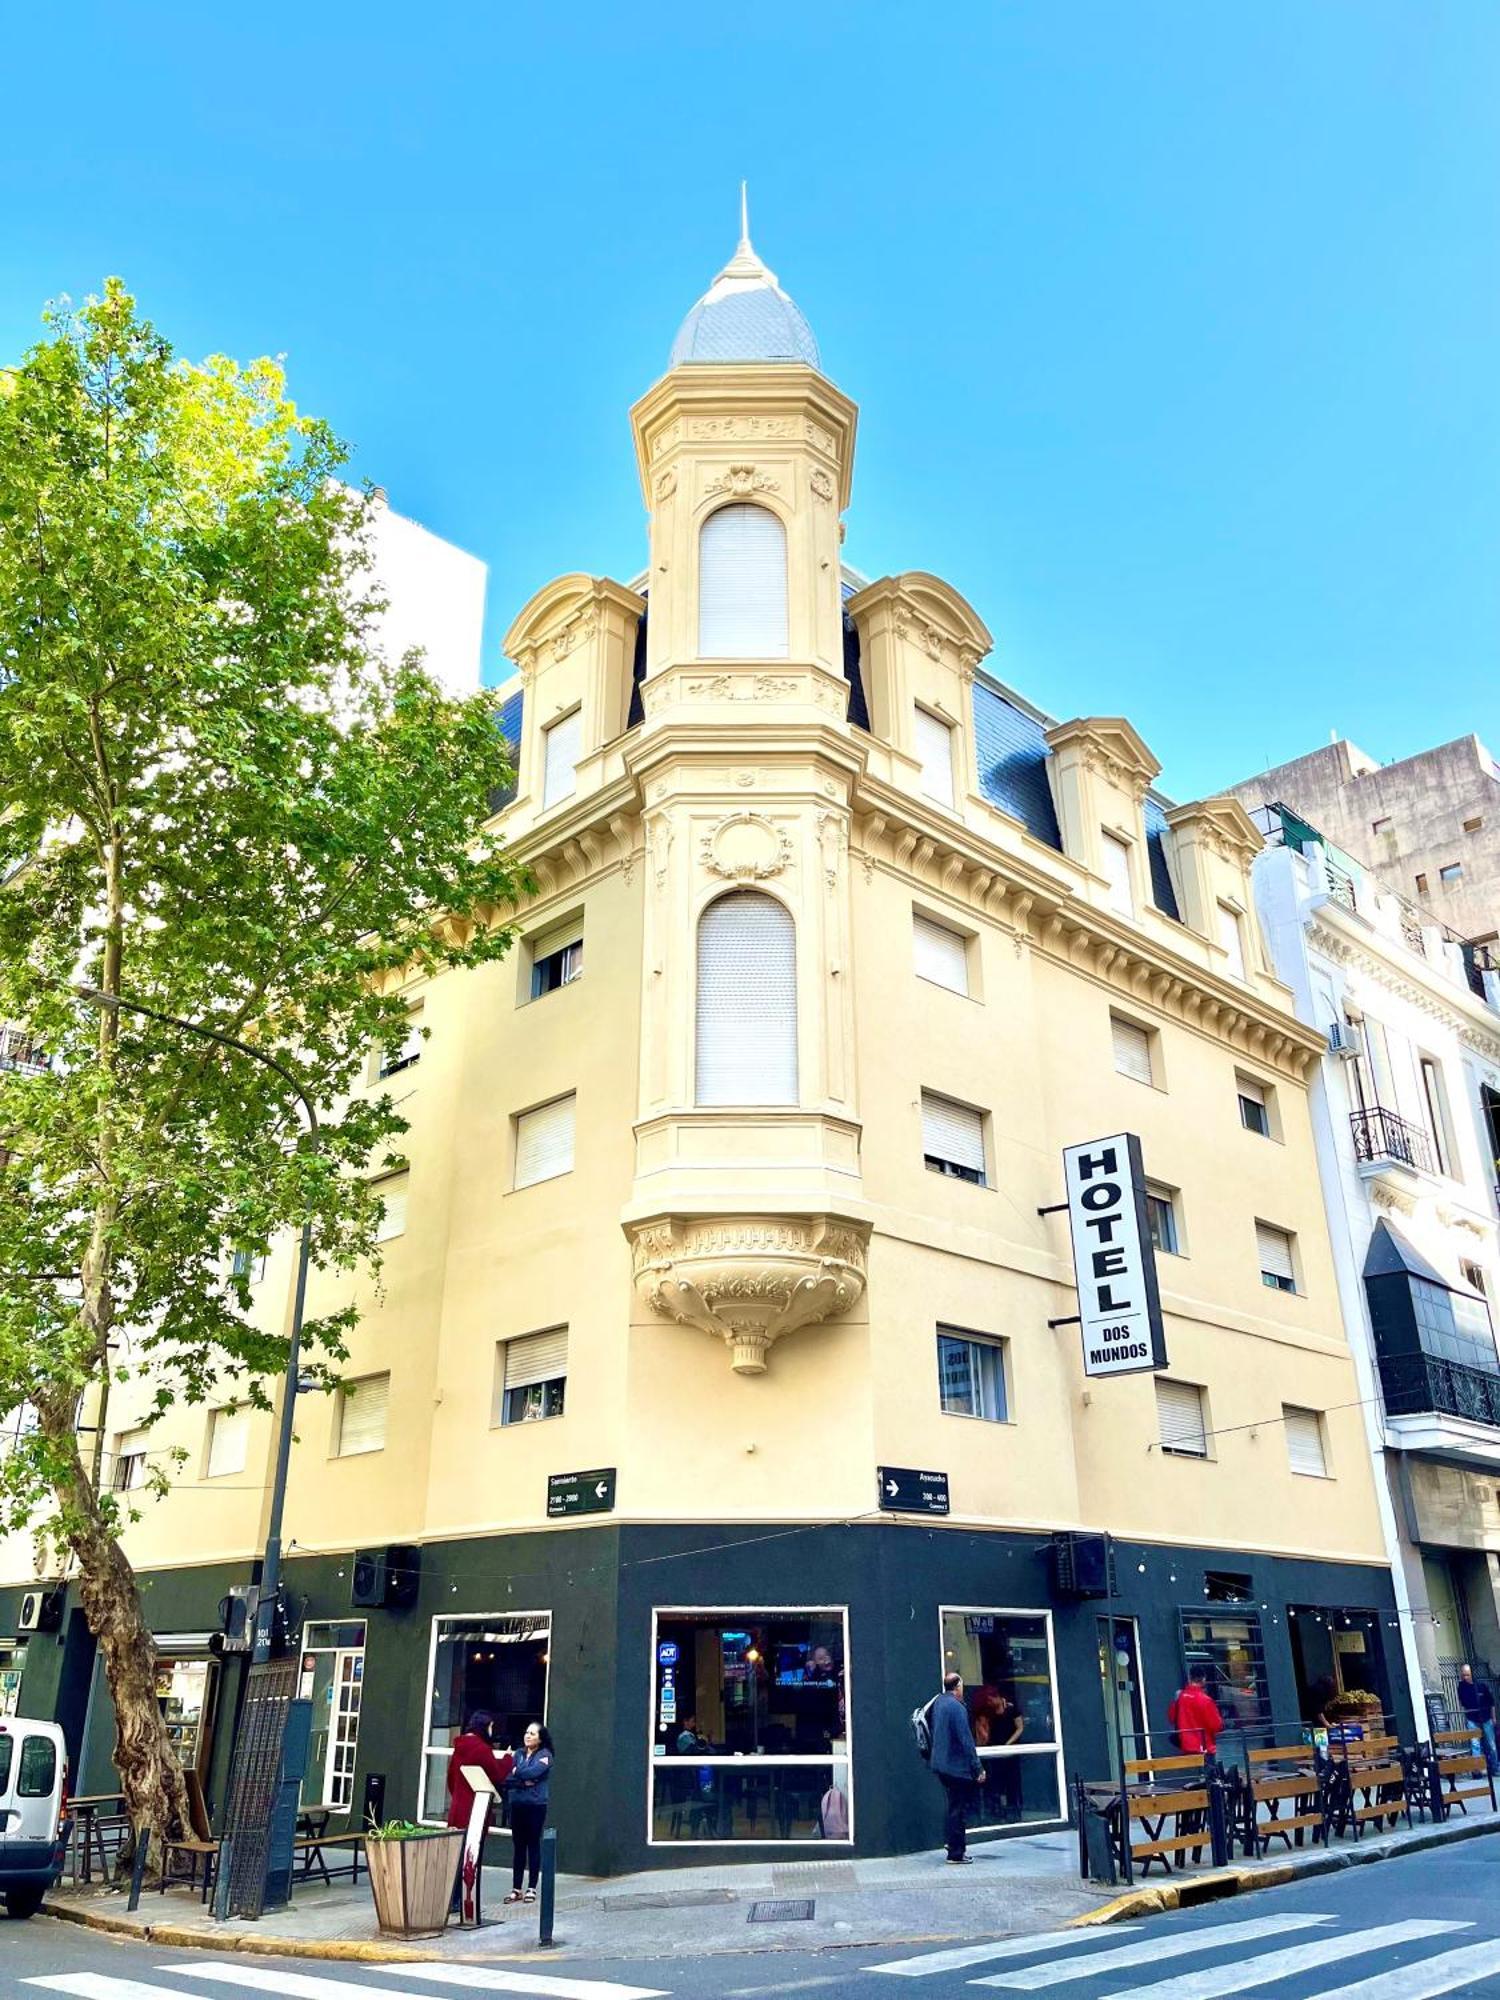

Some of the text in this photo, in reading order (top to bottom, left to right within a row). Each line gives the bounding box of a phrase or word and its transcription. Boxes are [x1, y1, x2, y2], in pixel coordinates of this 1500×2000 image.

[1078, 1147, 1131, 1313] HOTEL
[1102, 1325, 1130, 1342] DOS
[1090, 1342, 1148, 1365] MUNDOS
